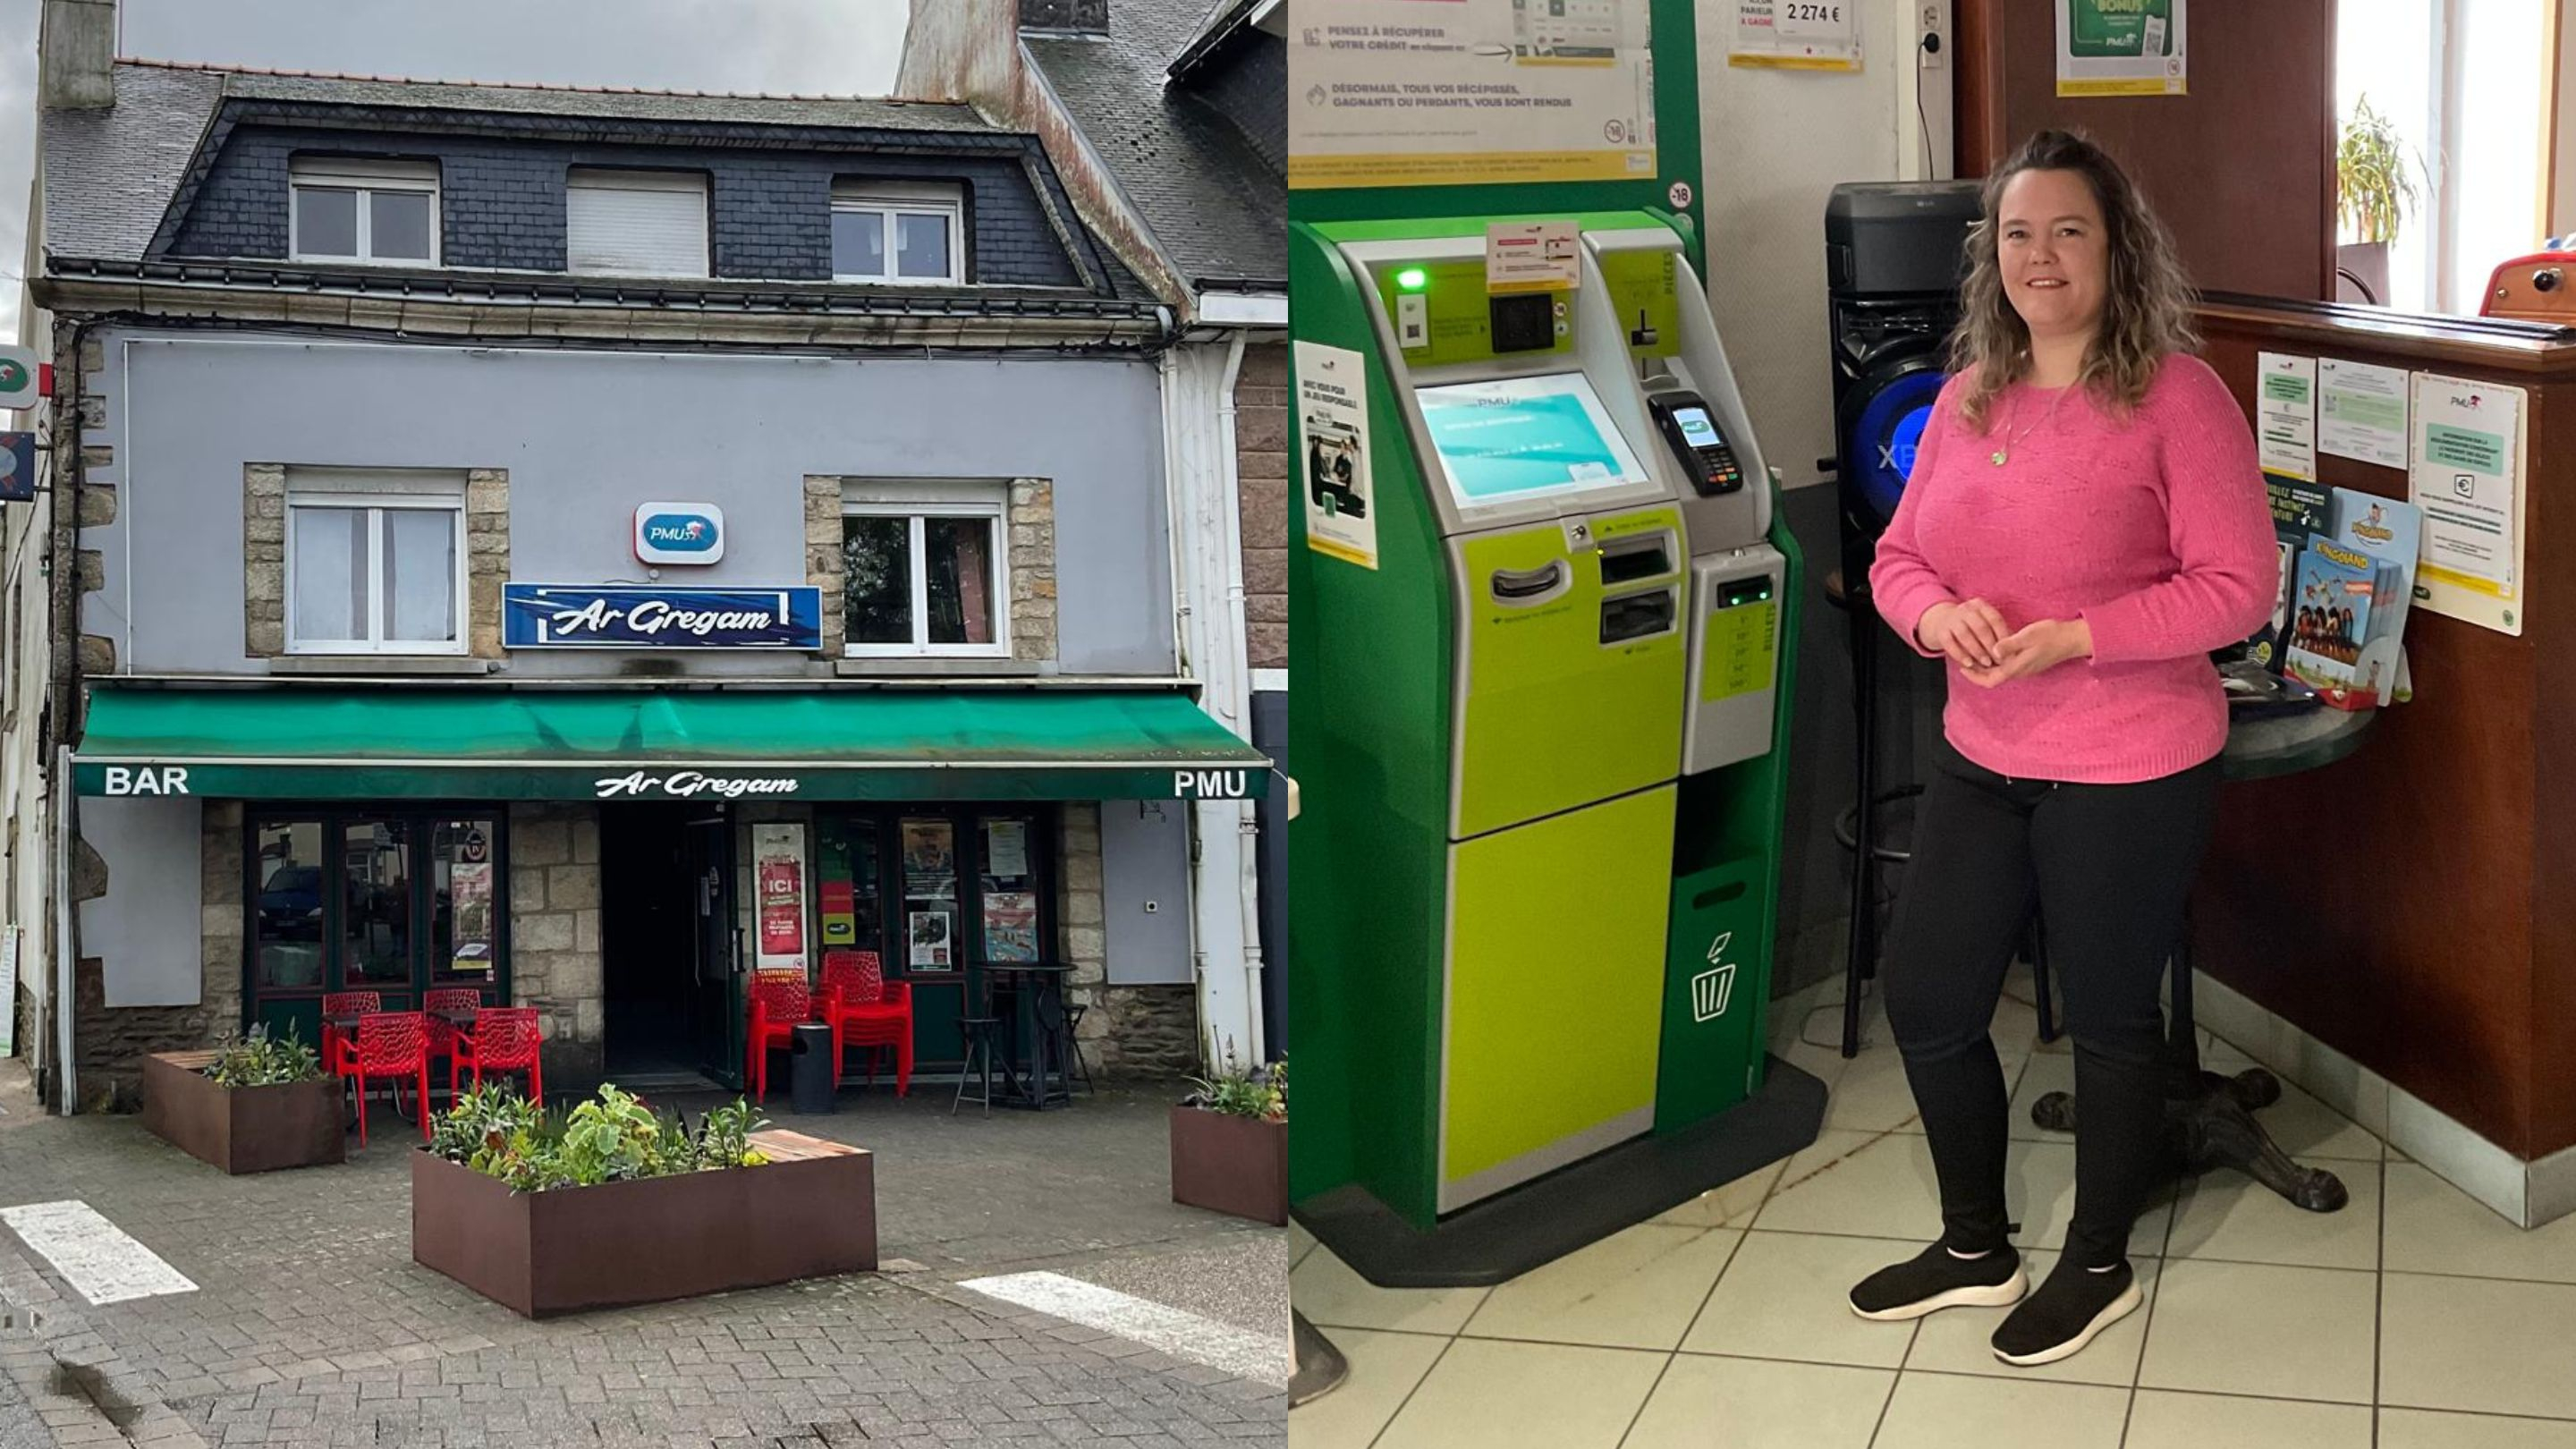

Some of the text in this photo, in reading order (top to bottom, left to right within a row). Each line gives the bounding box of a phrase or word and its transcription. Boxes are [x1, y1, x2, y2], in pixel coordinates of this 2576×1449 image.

[1787, 4, 1840, 22] 2 274 €
[1327, 26, 1368, 37] PENSEZ
[1329, 40, 1364, 50] VOTRE
[1368, 39, 1407, 51] CRÉDIT
[1402, 84, 1431, 94] TOUS
[1433, 84, 1455, 94] VOS
[1333, 97, 1394, 107] GAGNANTS
[1397, 97, 1413, 106] OU
[1475, 97, 1503, 107] VOUS
[1504, 97, 1531, 107] SONT
[1533, 98, 1572, 107] RENDUS
[649, 526, 686, 541] PMU
[552, 597, 772, 636] Ar Gregam
[105, 767, 190, 795] BAR
[594, 770, 799, 799] Ar Gregam
[1174, 769, 1246, 798] PMU
[768, 879, 792, 893] ICI
